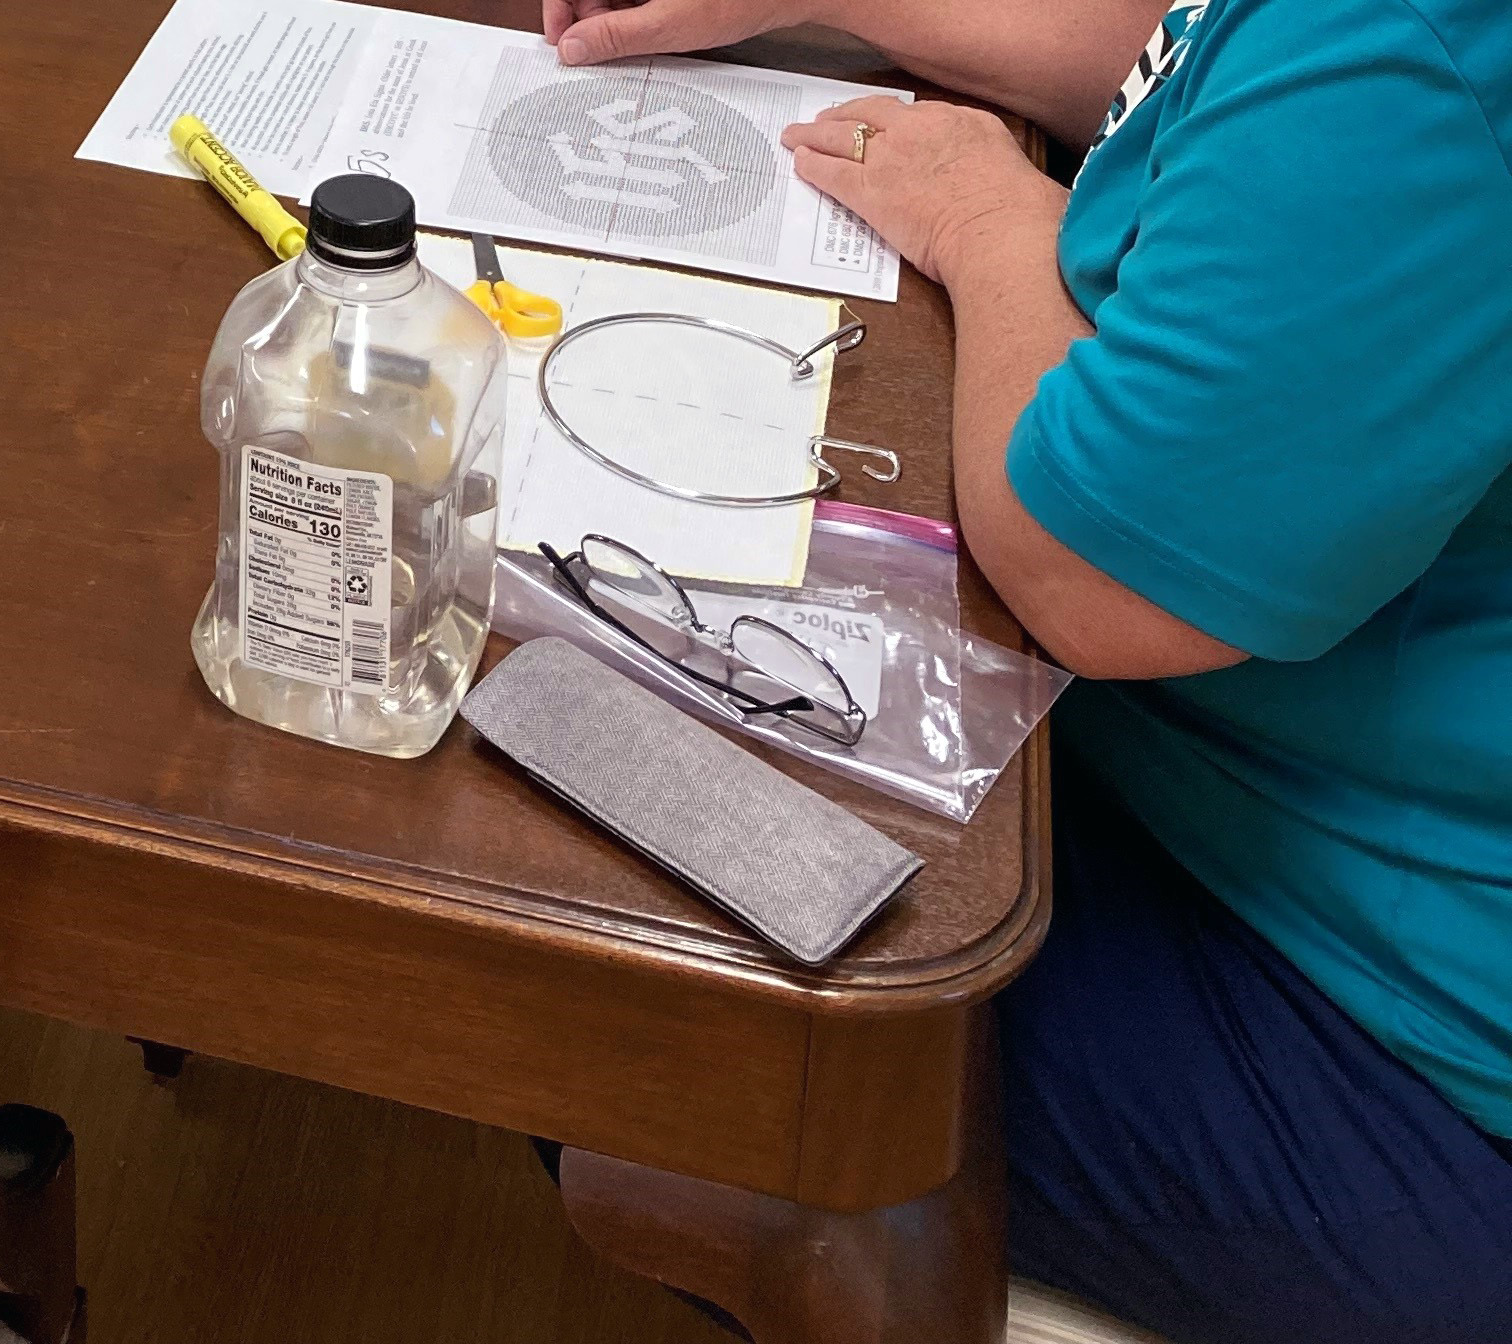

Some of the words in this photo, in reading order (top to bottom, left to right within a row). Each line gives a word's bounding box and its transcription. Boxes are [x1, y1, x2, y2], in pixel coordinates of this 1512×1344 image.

[250, 457, 302, 488] Nutrition
[307, 476, 342, 496] Facts
[250, 483, 274, 499] Serving
[275, 490, 288, 502] size
[249, 504, 298, 529] Calories
[309, 518, 341, 538] 130
